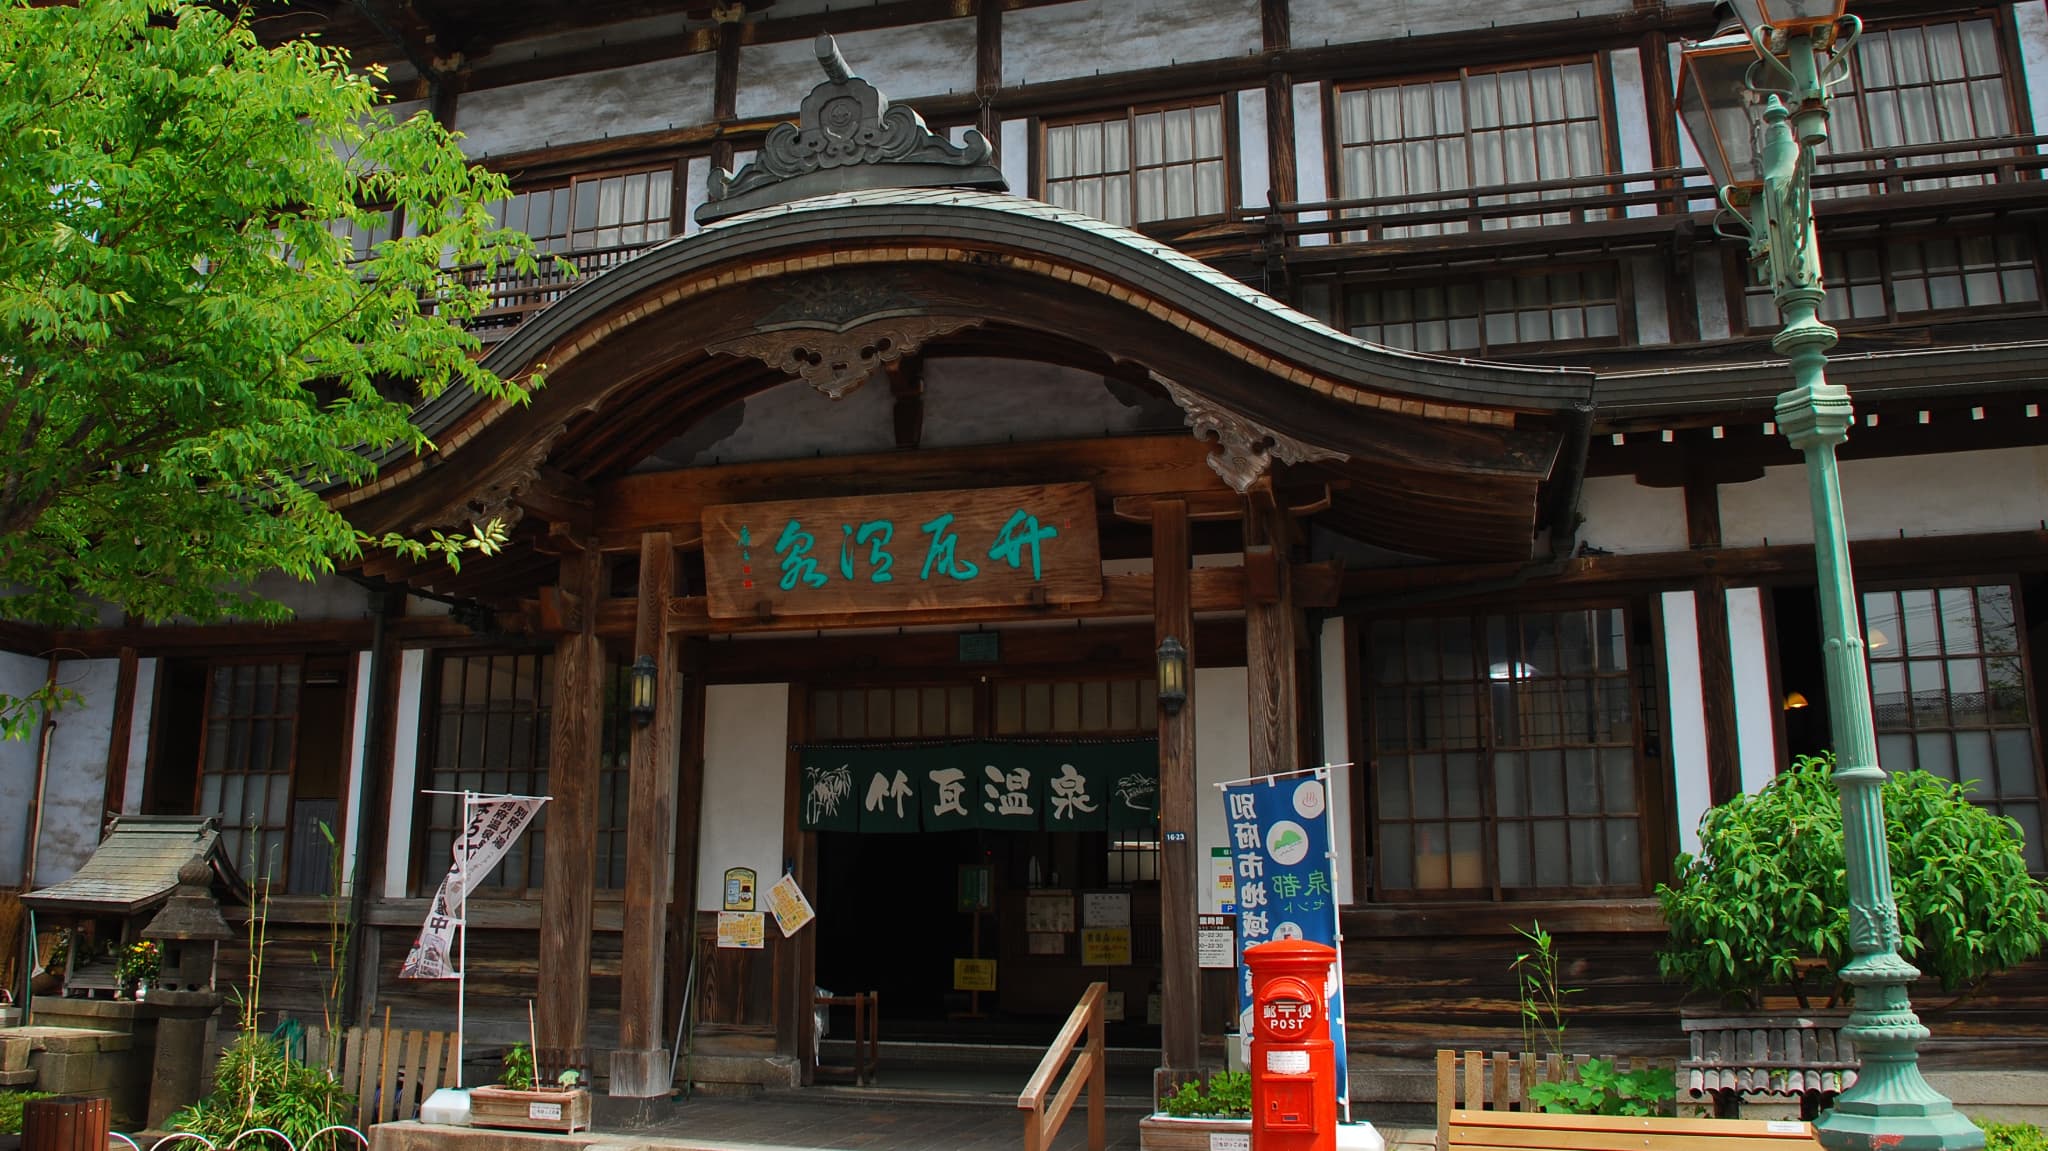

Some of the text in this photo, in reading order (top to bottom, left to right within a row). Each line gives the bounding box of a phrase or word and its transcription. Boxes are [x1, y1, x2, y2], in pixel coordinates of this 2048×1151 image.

[864, 763, 1099, 820] 竹瓦温泉
[1270, 1019, 1305, 1030] POST
